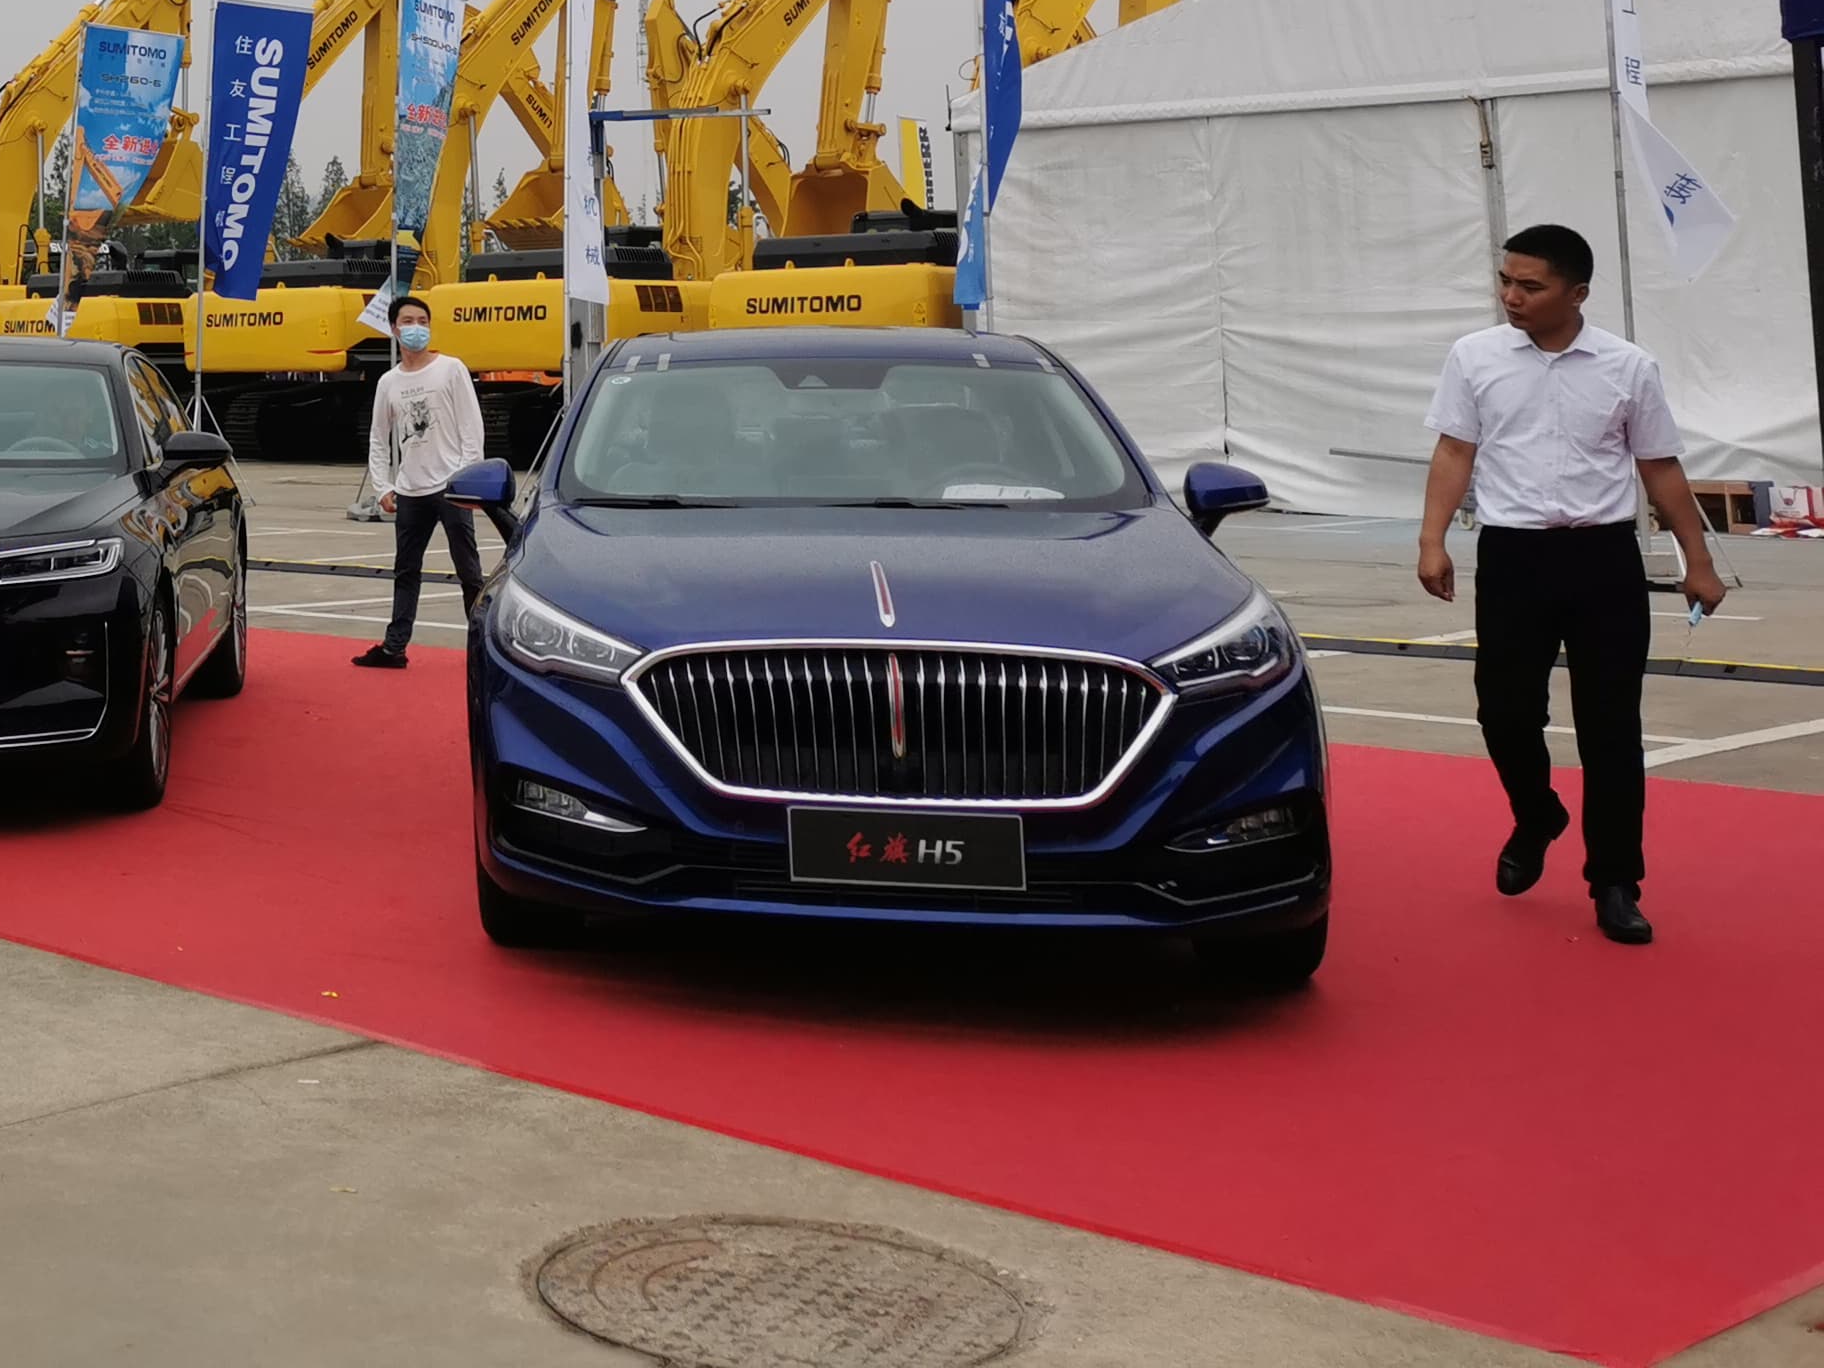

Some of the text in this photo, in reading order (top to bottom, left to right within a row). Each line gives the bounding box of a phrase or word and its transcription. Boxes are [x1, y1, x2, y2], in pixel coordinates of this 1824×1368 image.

[98, 40, 167, 60] SUMITOMO
[306, 10, 359, 70] SUMITOMO
[526, 94, 552, 129] SUMIT
[221, 36, 284, 272] SUMITOMO
[453, 305, 547, 322] SUMITOMO
[746, 294, 862, 314] SUMITOMO
[4, 319, 56, 334] SUMITOM
[205, 311, 284, 328] SUMITOMO
[846, 832, 965, 865] 红旗 H5
